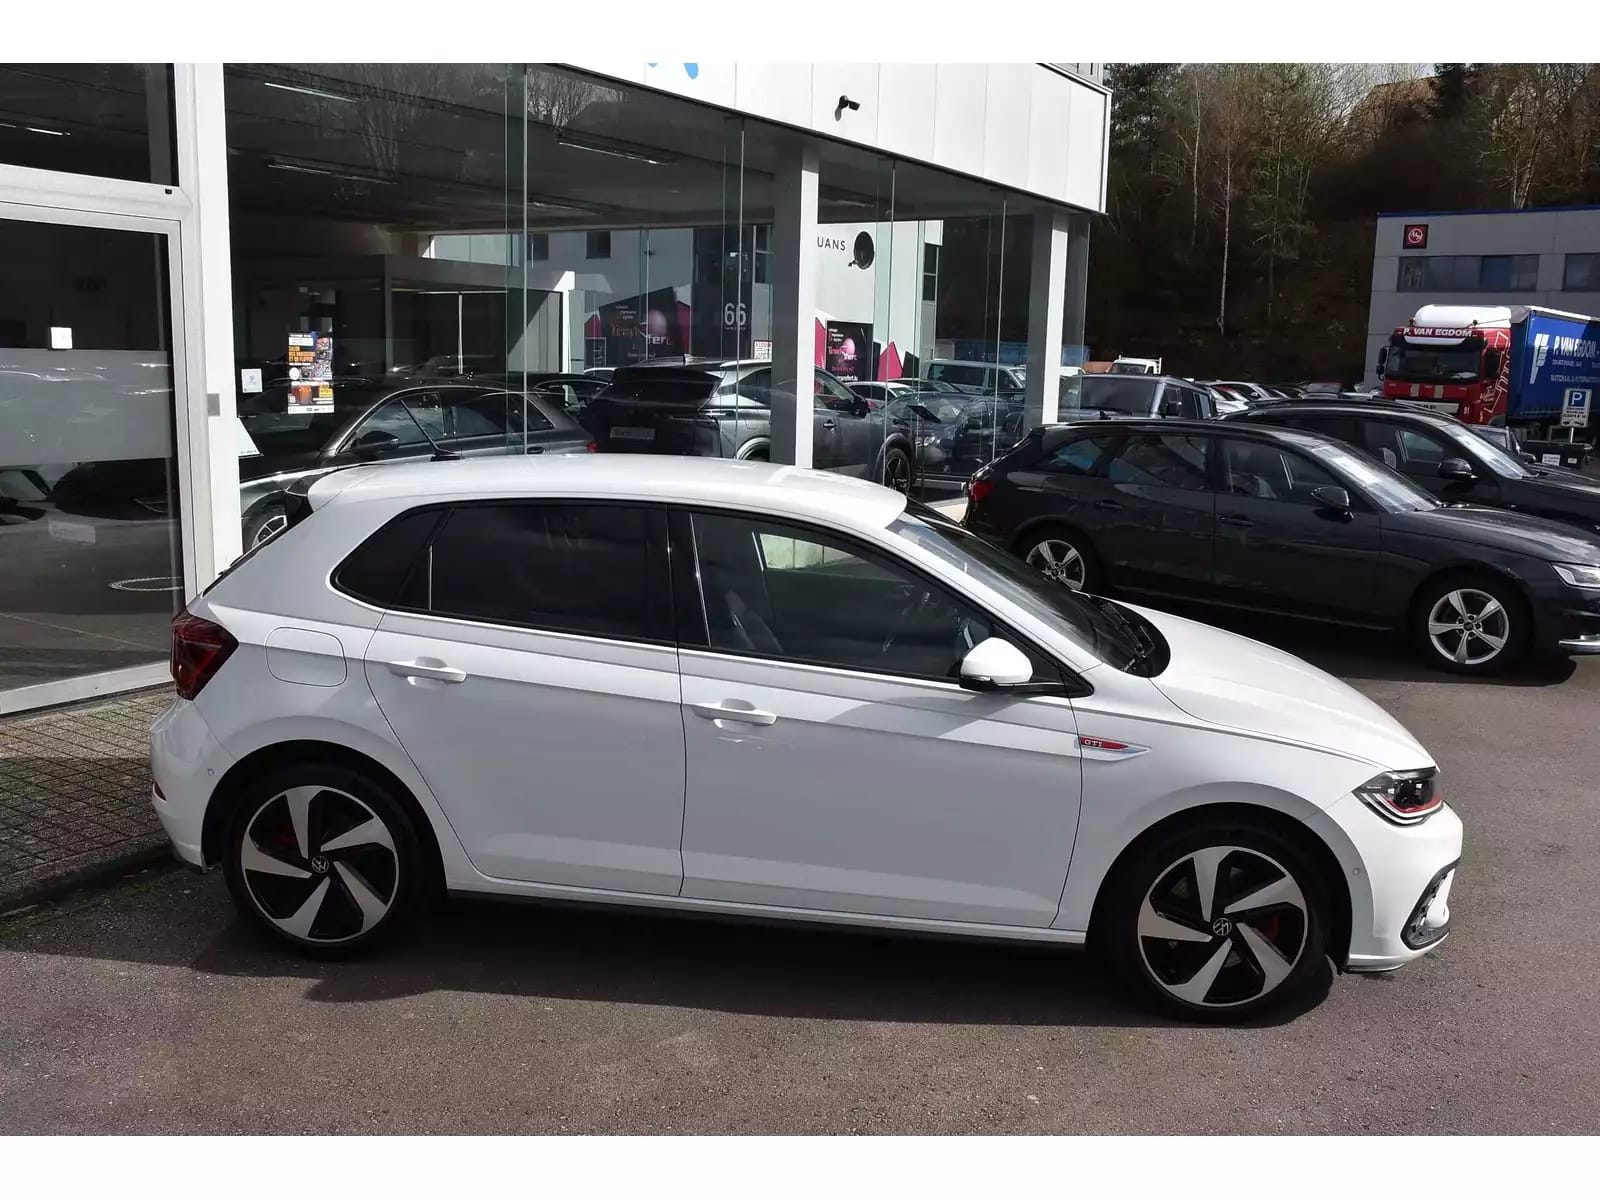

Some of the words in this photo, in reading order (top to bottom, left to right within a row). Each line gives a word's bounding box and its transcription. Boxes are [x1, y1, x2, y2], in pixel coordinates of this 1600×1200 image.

[724, 302, 747, 326] 66
[1414, 327, 1432, 336] VAN
[1434, 328, 1473, 337] EGDOM
[1571, 391, 1583, 406] P
[1084, 739, 1104, 748] GTI
